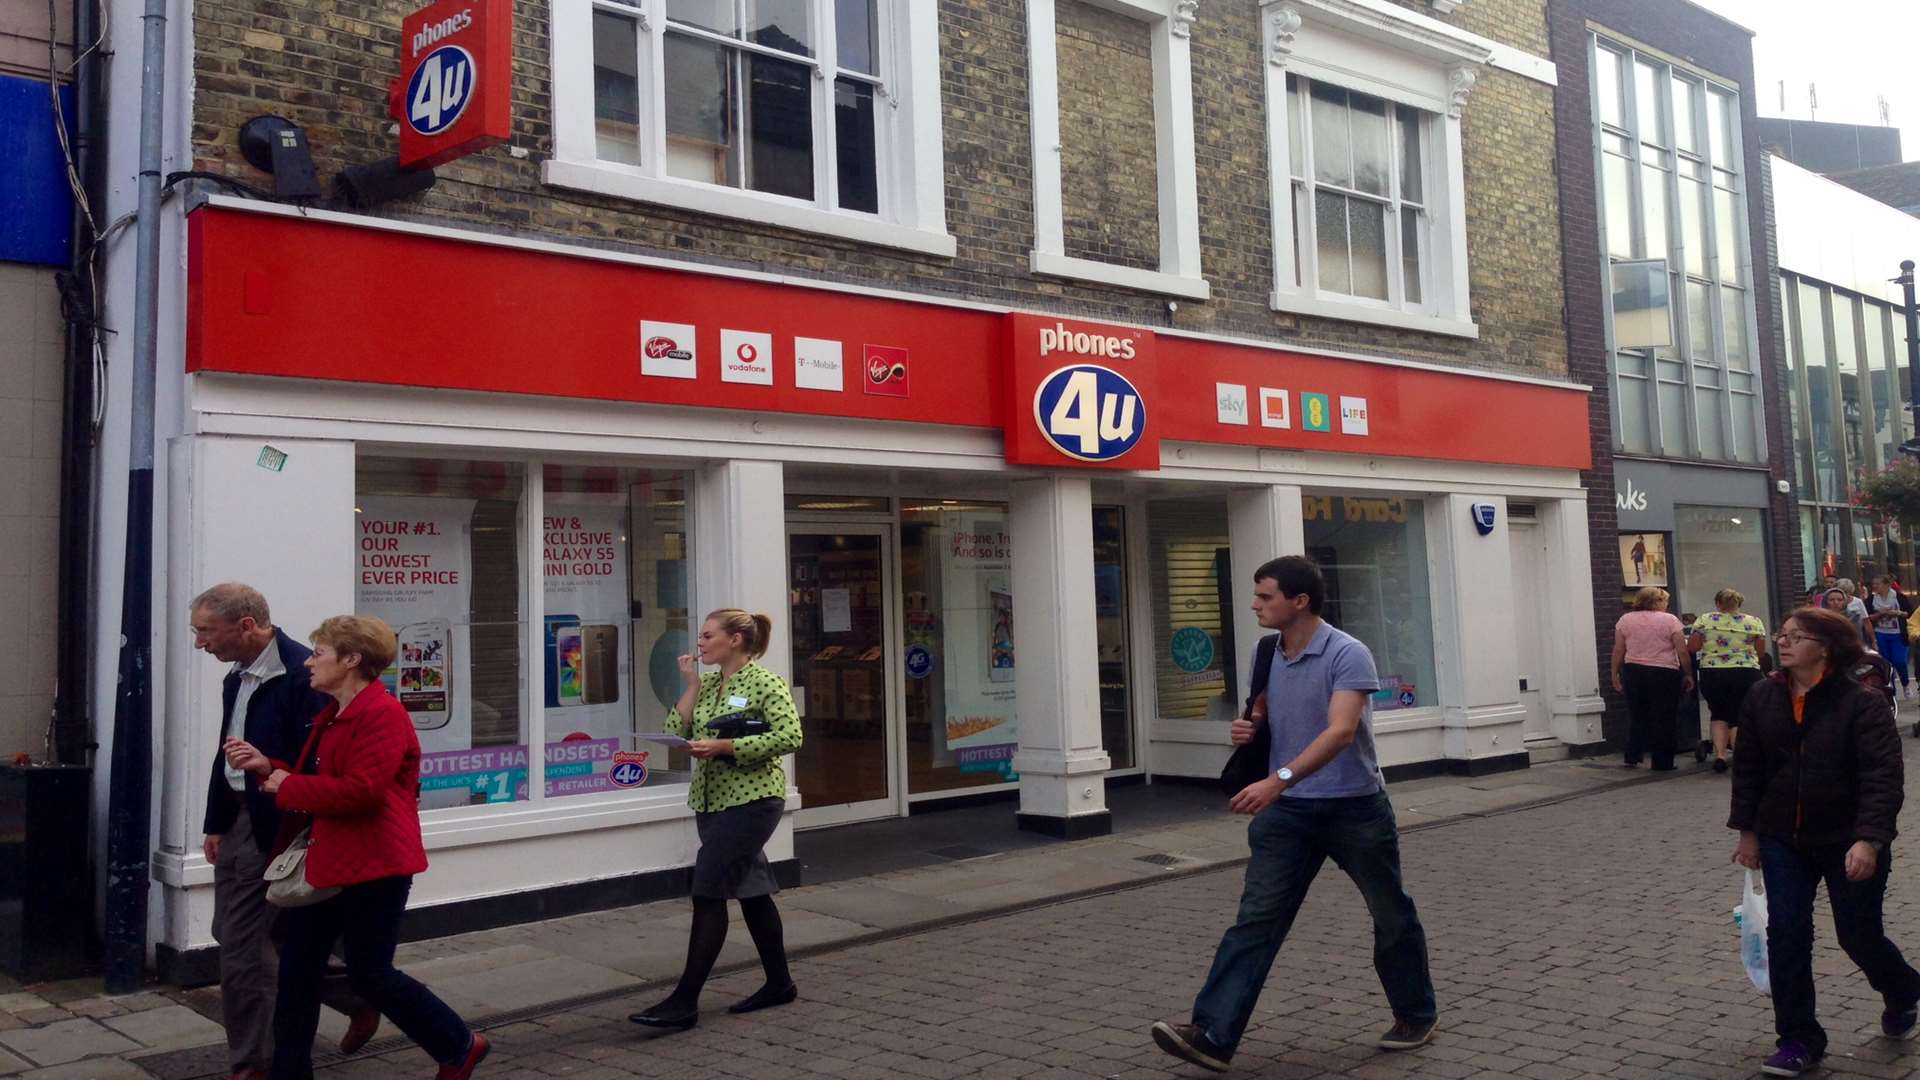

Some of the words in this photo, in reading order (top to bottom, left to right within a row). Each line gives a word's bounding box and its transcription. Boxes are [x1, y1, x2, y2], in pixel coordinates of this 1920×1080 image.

[412, 9, 472, 58] phones
[412, 54, 466, 130] 4u
[648, 338, 672, 357] Virgin
[1040, 323, 1136, 359] phones
[668, 351, 690, 359] mobile
[728, 364, 767, 373] vodafone
[1050, 371, 1137, 454] 4u
[1219, 394, 1245, 417] sky
[1342, 406, 1366, 420] LIFE
[361, 520, 409, 535] YOUR
[412, 522, 441, 536] #1.
[543, 517, 567, 530] EW
[570, 517, 582, 530] &
[361, 538, 399, 551] OUR
[543, 533, 612, 545] XCLUSIVE
[543, 548, 592, 561] ALAXY
[596, 548, 614, 560] S5
[953, 546, 976, 558] And
[979, 549, 992, 558] so
[362, 554, 431, 568] LOWEST
[543, 563, 567, 577] INI
[572, 563, 612, 576] GOLD
[362, 571, 406, 585] EVER
[411, 571, 459, 585] PRICE
[615, 751, 645, 762] phones
[420, 753, 494, 775] OTTEST
[615, 764, 642, 784] 4u
[475, 771, 511, 801] #1
[558, 776, 607, 791] RETAILER
